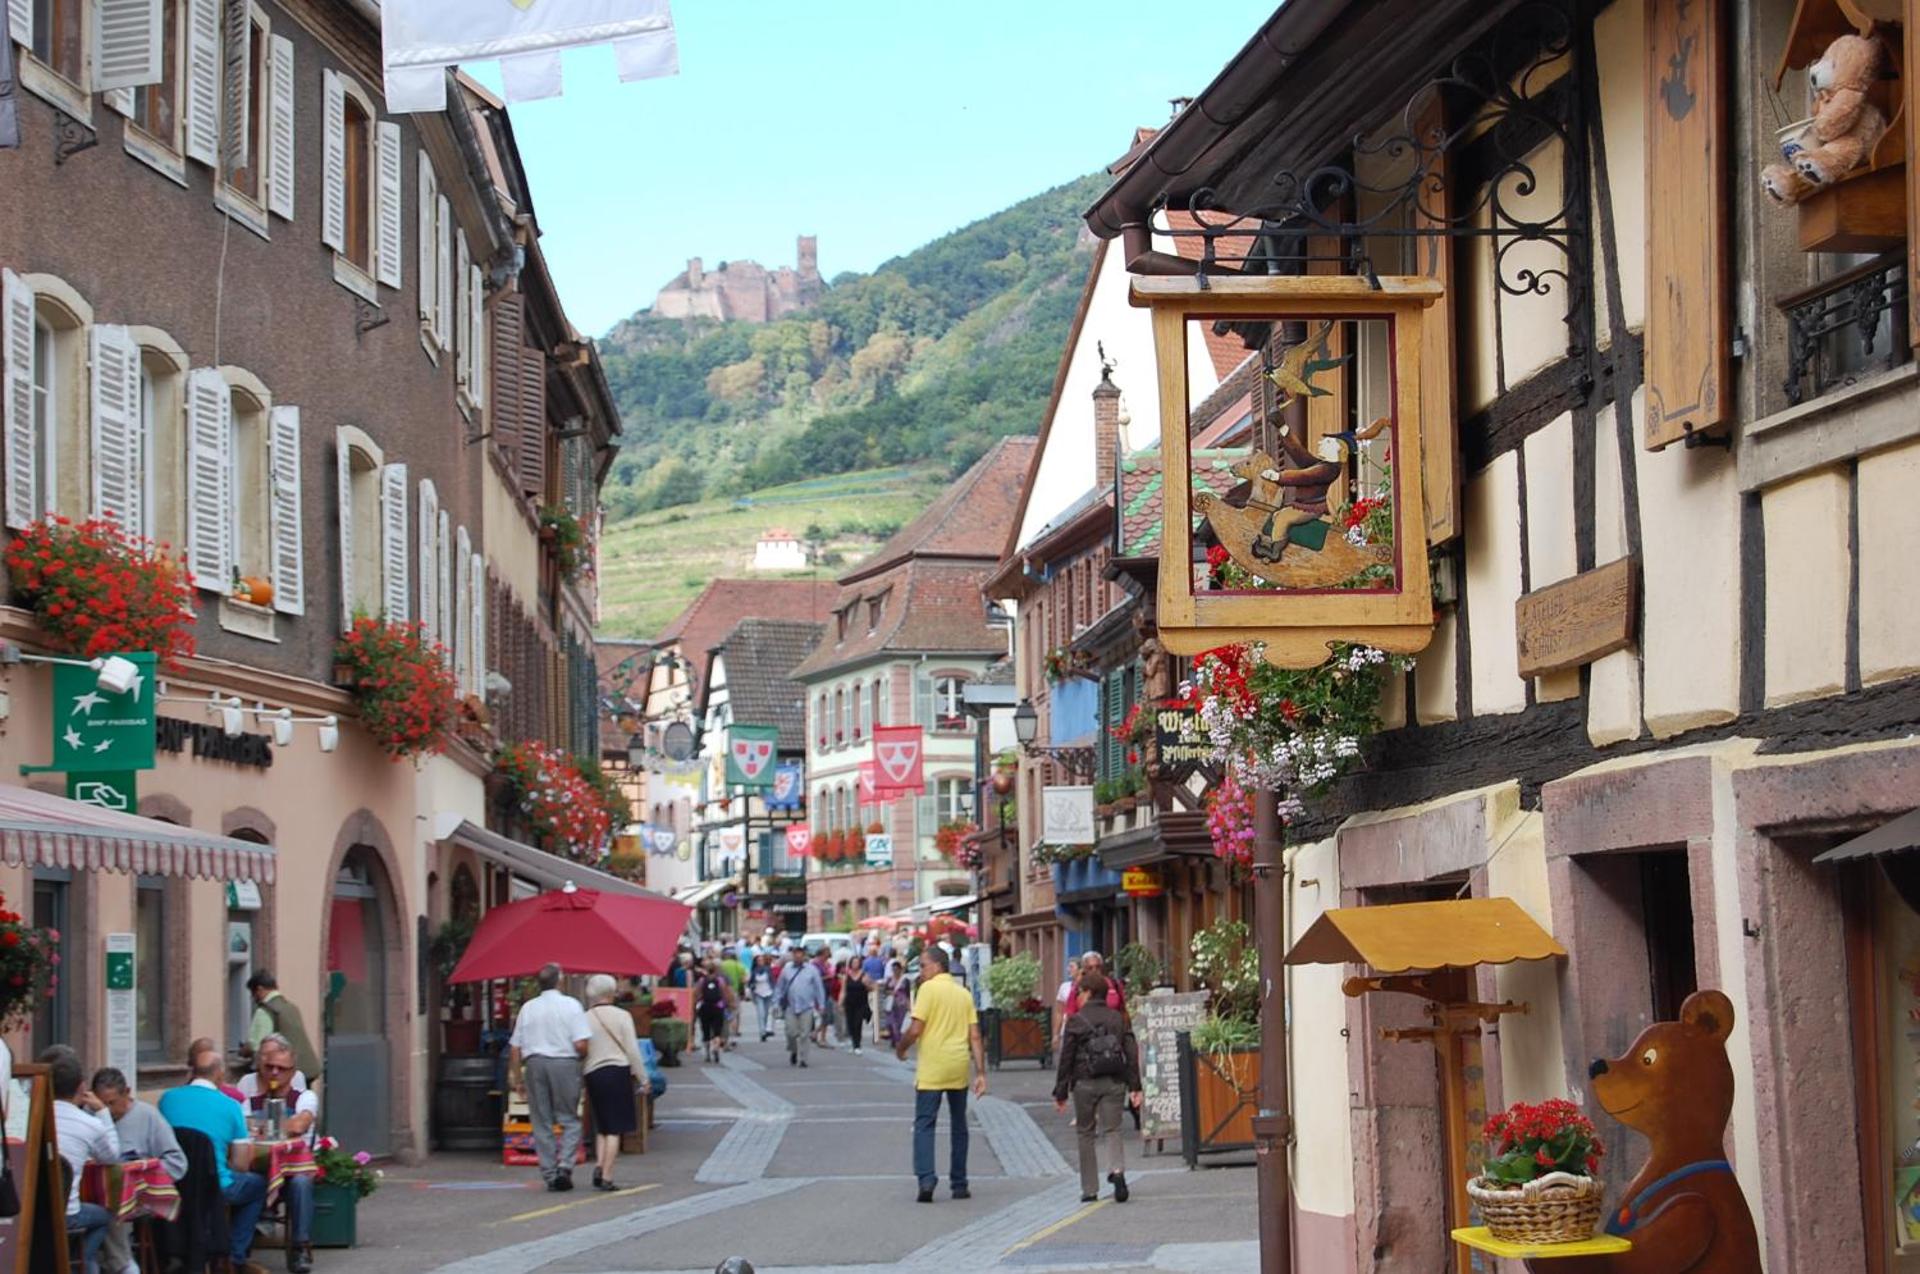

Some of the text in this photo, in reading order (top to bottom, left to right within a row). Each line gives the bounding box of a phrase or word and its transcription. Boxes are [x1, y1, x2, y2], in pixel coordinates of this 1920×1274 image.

[87, 718, 148, 727] BNP PARIBAS
[156, 715, 273, 769] BNP PARIBAS
